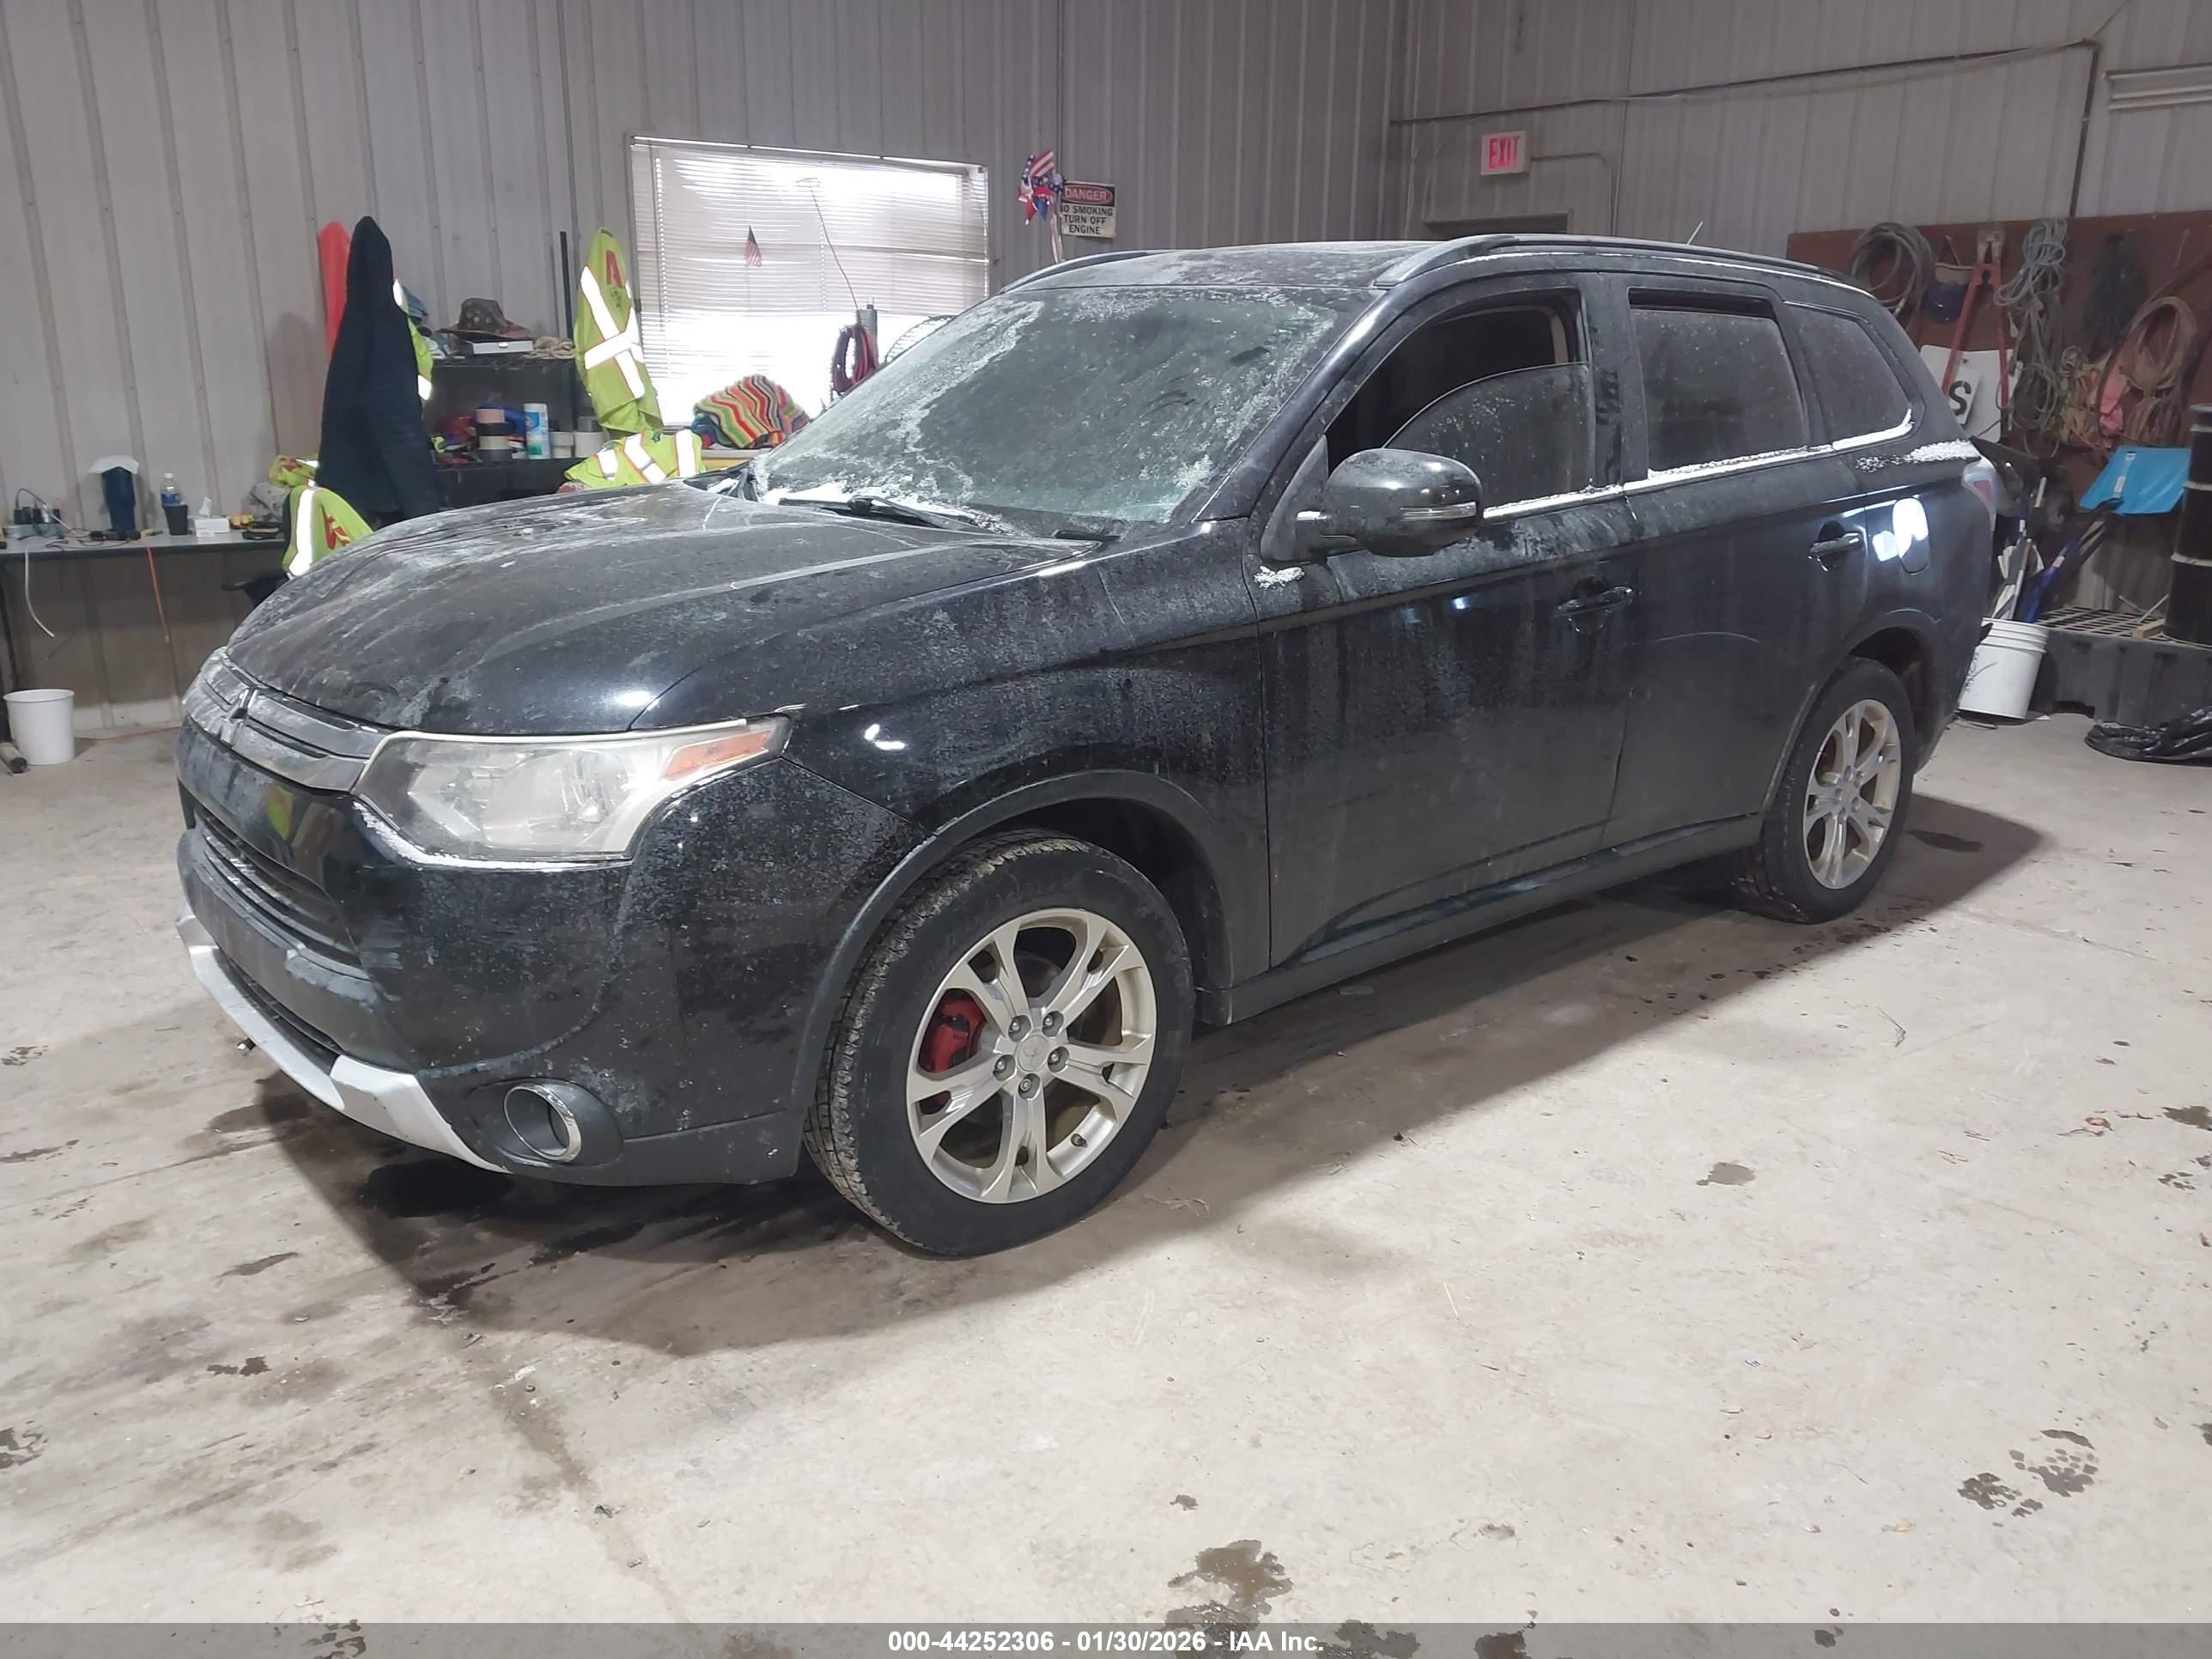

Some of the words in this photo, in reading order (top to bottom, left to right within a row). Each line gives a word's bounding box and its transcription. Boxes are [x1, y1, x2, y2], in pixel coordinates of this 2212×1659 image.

[1489, 137, 1519, 169] EXIT
[1065, 188, 1107, 202] DANGER
[1073, 206, 1114, 216] SMOKING
[1064, 215, 1087, 223] TURN
[1069, 224, 1101, 234] ENGINE
[1949, 380, 1972, 416] S
